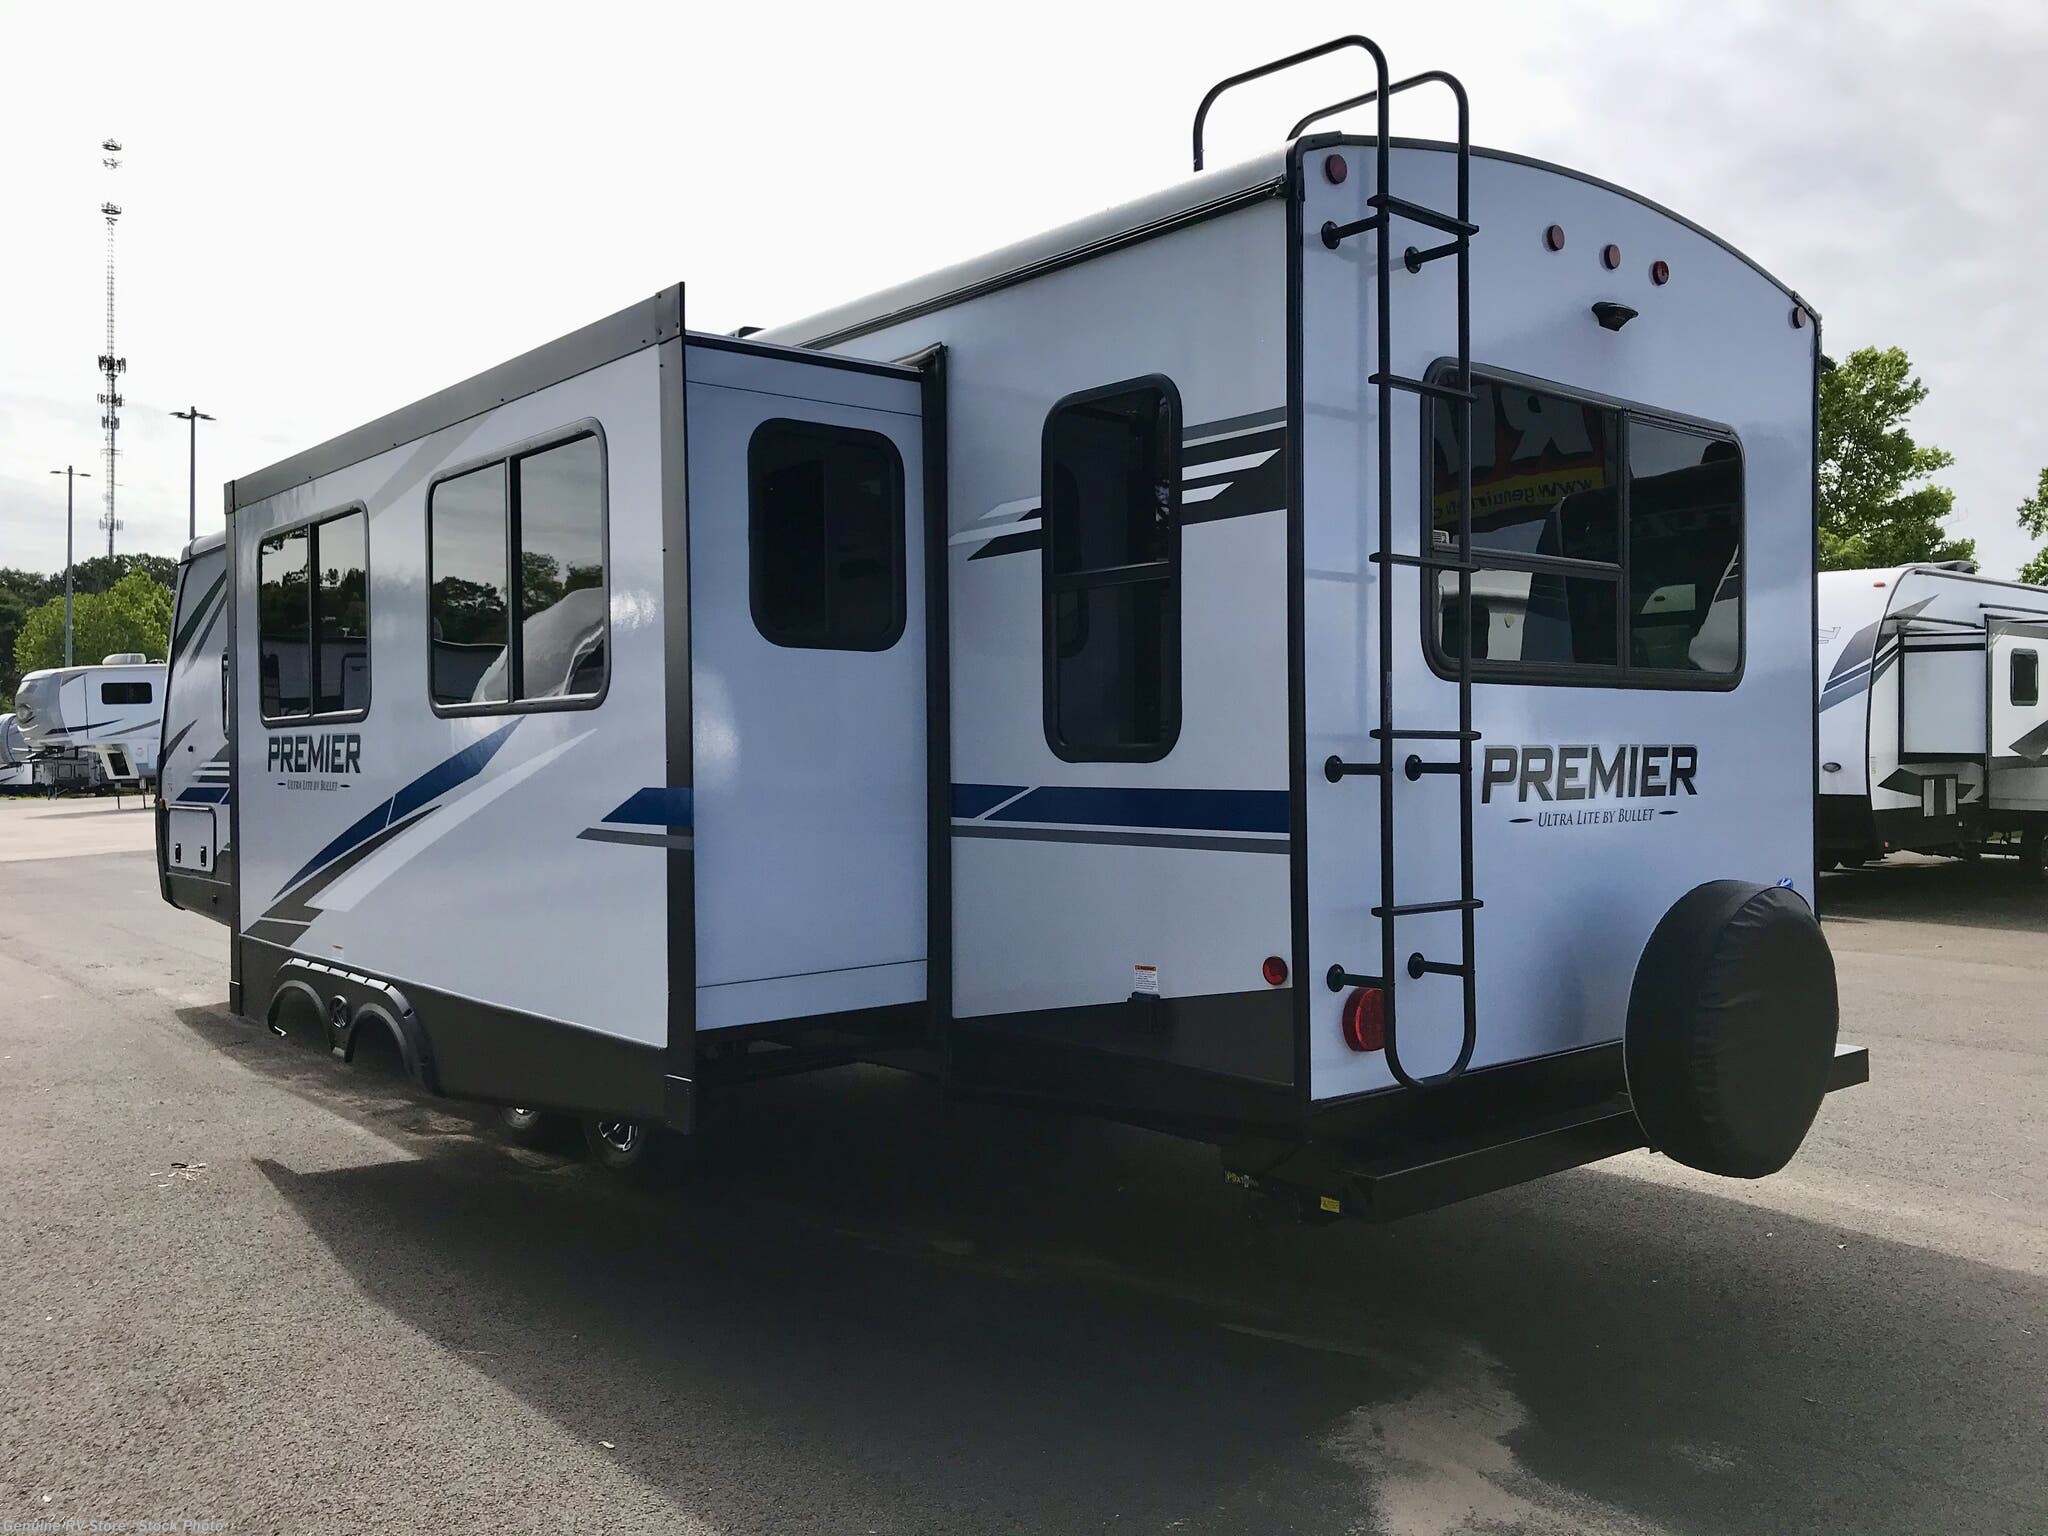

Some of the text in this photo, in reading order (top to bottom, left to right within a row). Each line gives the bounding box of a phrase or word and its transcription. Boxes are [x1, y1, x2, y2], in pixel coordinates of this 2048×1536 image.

[268, 735, 361, 773] PREMIER
[1481, 744, 1698, 804] PREMIER
[1538, 808, 1655, 827] ULTRA LITE BY BULLET
